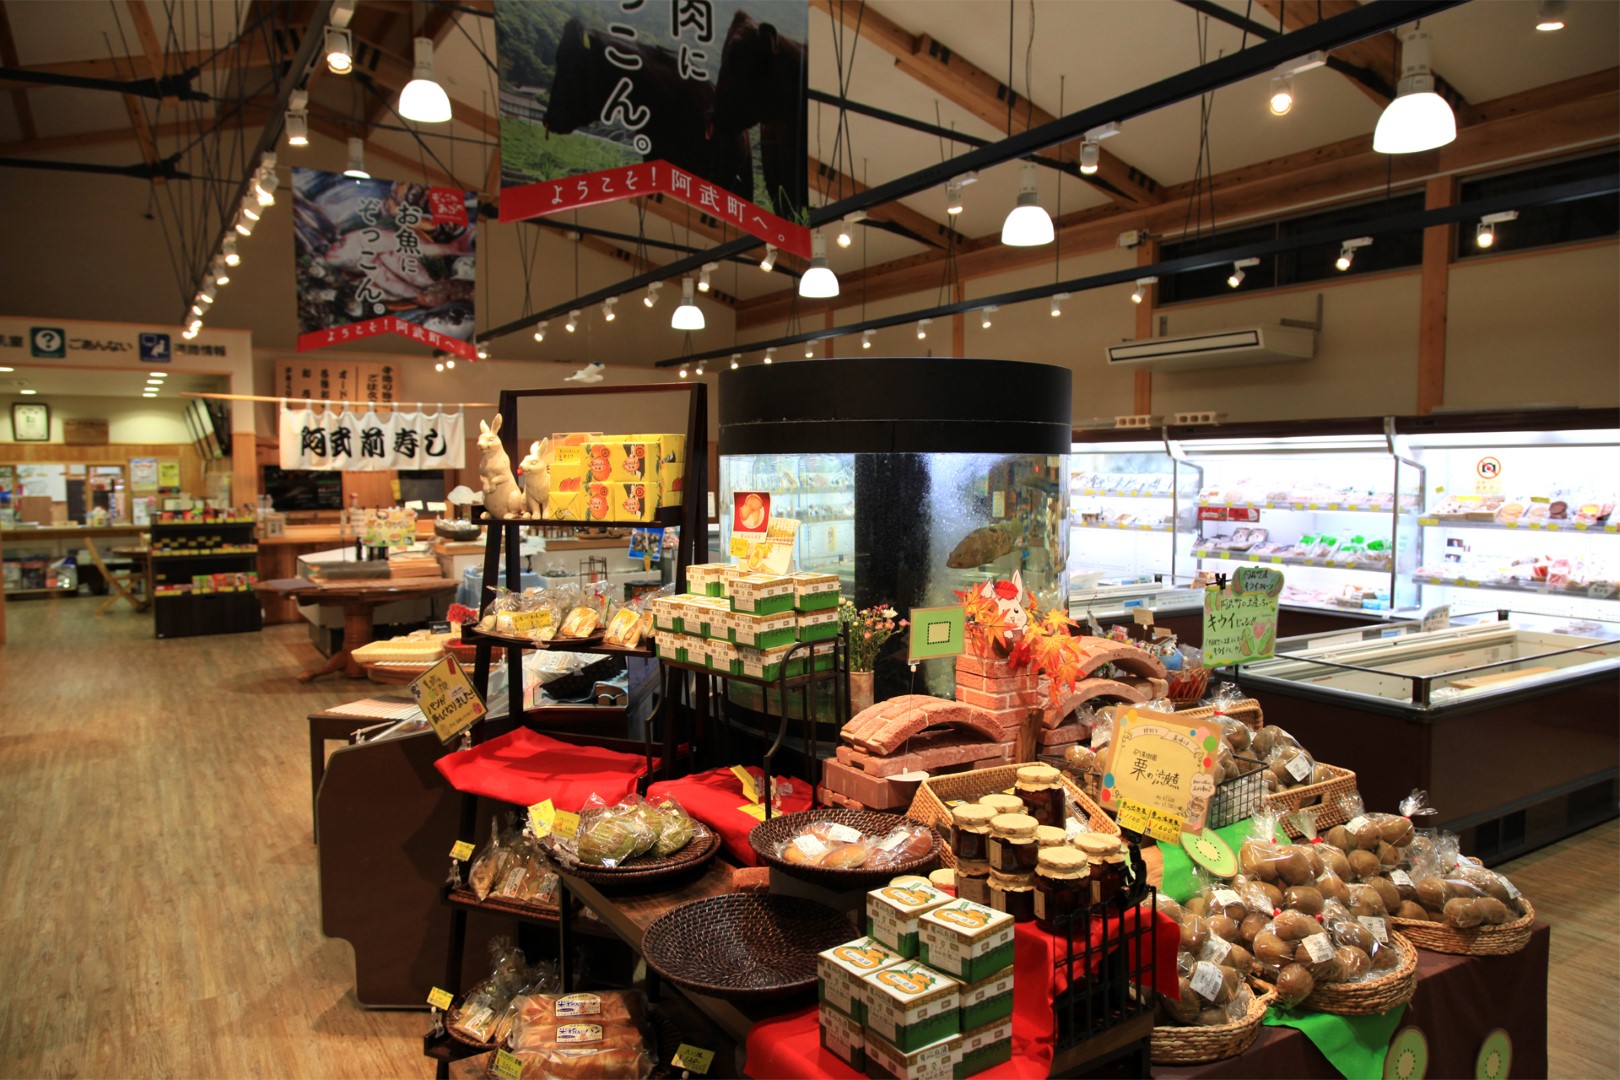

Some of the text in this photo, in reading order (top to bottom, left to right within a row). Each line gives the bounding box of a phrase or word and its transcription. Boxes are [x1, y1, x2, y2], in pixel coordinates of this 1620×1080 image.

[601, 0, 652, 153] こん。
[356, 198, 385, 315] ぞっこん。
[396, 203, 422, 274] お魚に
[68, 337, 133, 352] ごあんない
[426, 693, 447, 715] パンが
